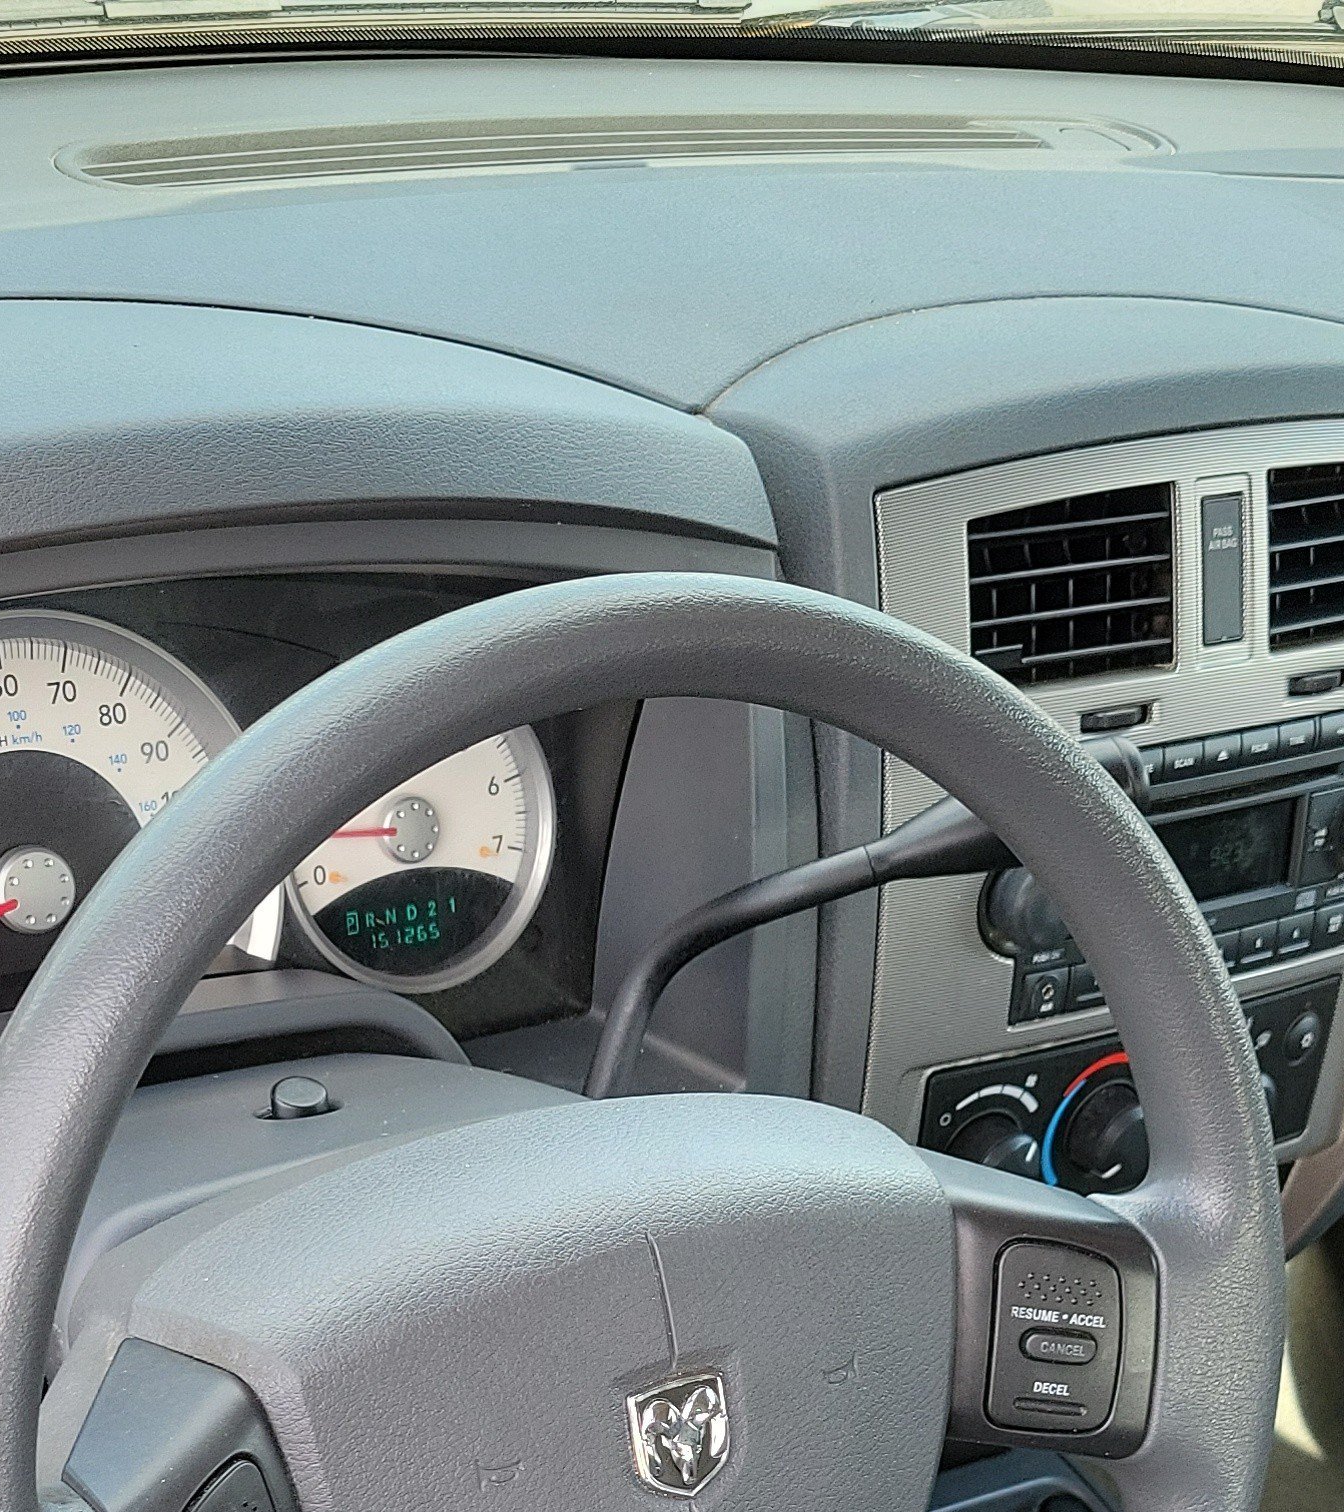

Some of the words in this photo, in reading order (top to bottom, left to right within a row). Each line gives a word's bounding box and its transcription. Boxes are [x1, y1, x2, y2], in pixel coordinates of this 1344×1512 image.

[1213, 526, 1233, 538] PASS
[47, 680, 77, 705] 70
[7, 709, 27, 722] 100
[99, 702, 127, 727] 80
[62, 723, 82, 736] 120
[12, 732, 43, 746] km/h
[108, 753, 128, 765] 140
[141, 740, 169, 764] 90
[488, 776, 499, 796] 6
[139, 801, 157, 812] 160
[492, 835, 503, 853] 7
[313, 865, 326, 885] 0
[366, 911, 375, 928] R
[386, 908, 397, 925] N
[407, 902, 418, 921] D
[428, 899, 437, 917] 2
[449, 896, 455, 913] 1
[1011, 1306, 1060, 1323] RESUME
[1069, 1313, 1106, 1328] ACCEL
[1040, 1341, 1086, 1357] CANCEL
[1033, 1381, 1070, 1397] DECEL
